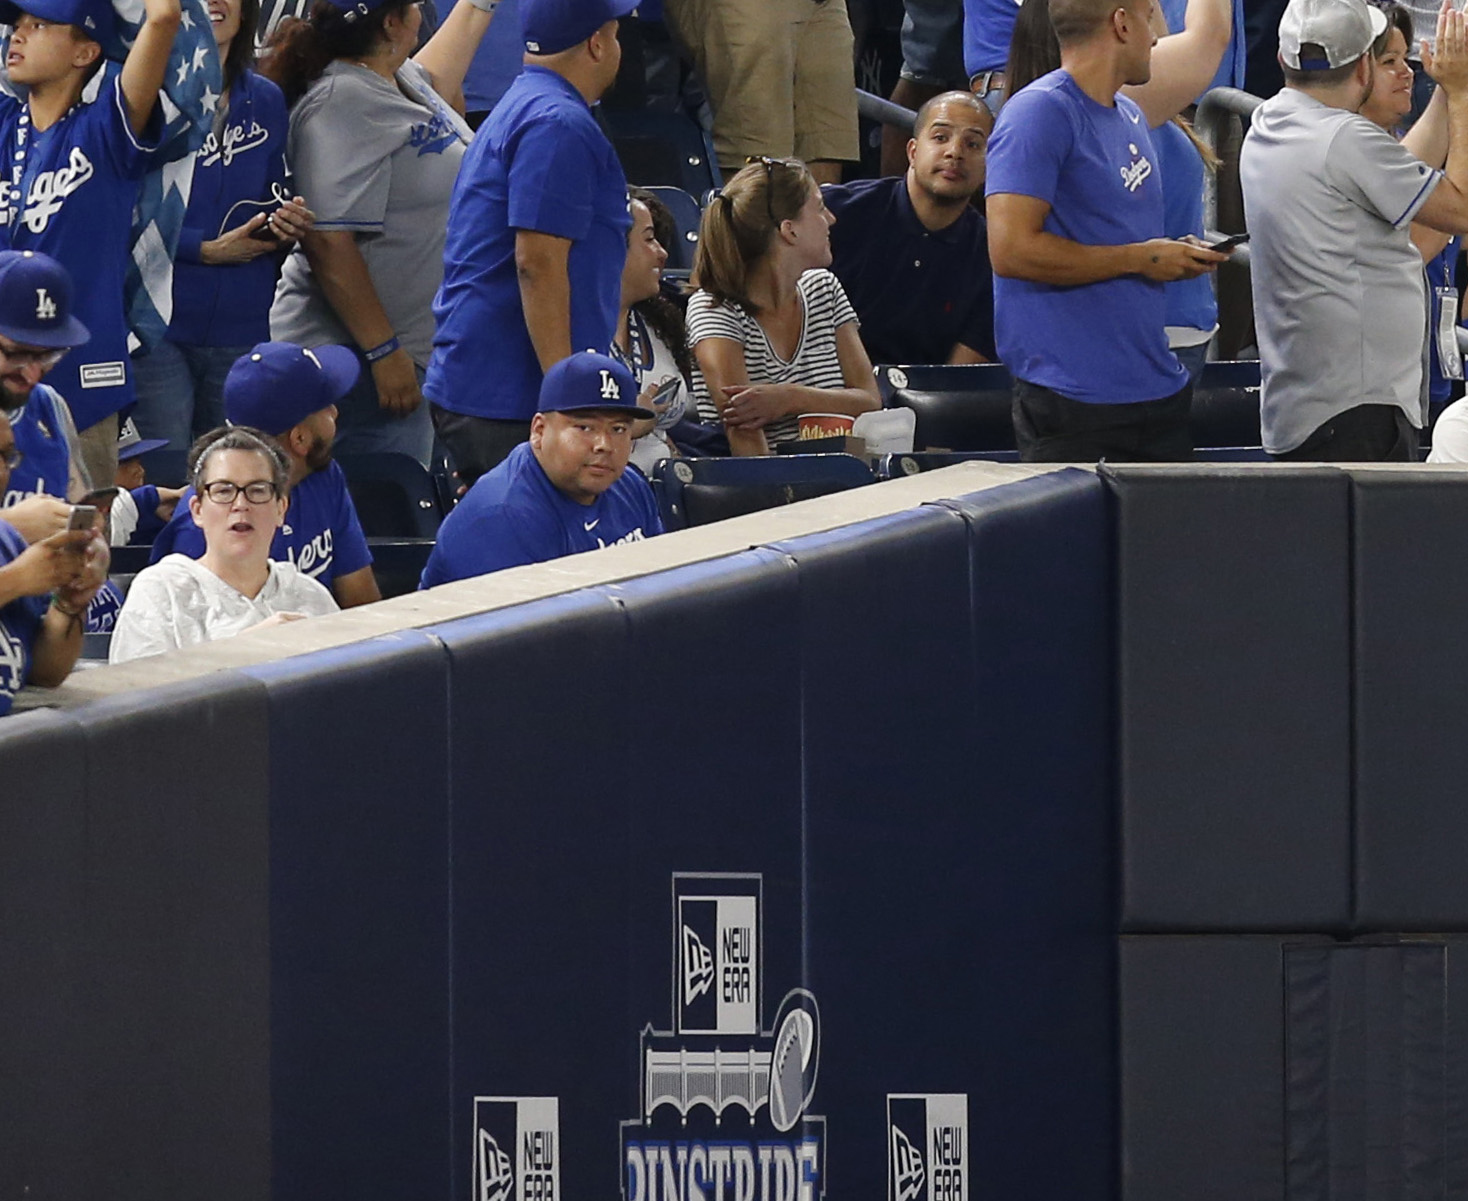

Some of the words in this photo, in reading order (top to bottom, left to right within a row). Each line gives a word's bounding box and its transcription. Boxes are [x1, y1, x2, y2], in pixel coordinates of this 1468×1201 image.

[36, 288, 57, 319] LA
[599, 370, 620, 400] LA
[723, 927, 751, 963] NEW
[723, 967, 751, 1003] ERA
[524, 1131, 553, 1170] NEW
[933, 1127, 961, 1165] NEW
[934, 1168, 962, 1201] ERA
